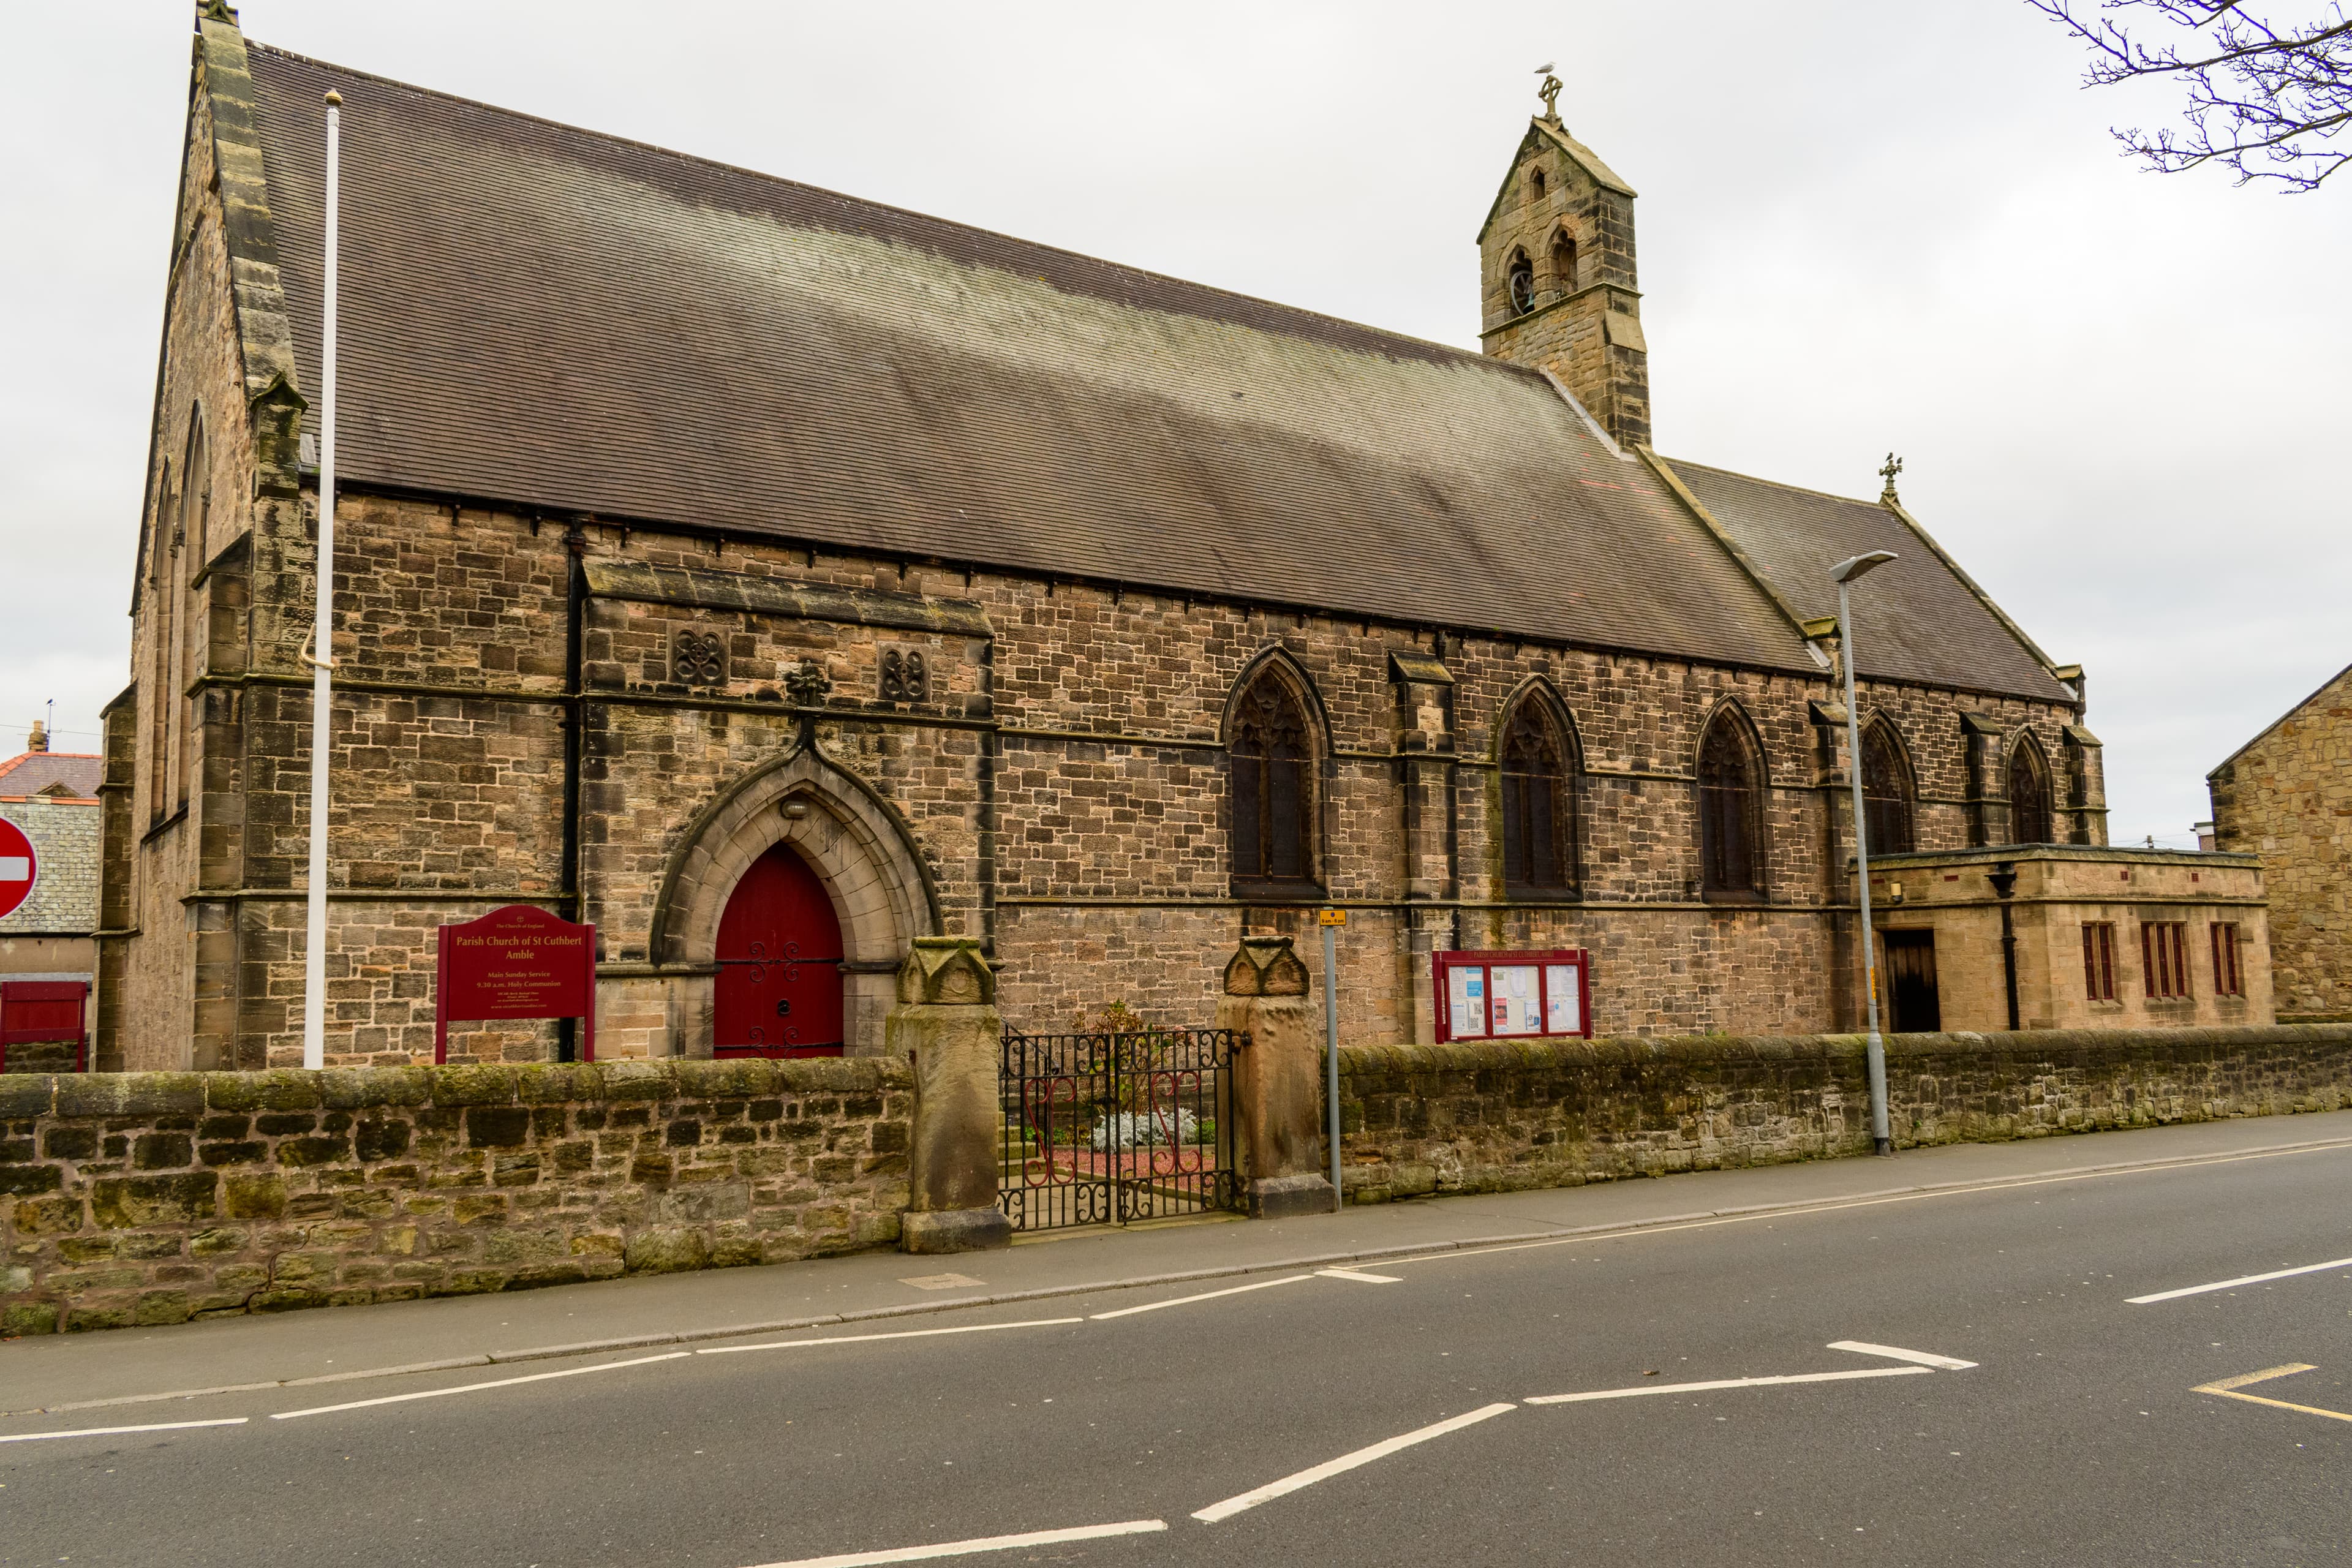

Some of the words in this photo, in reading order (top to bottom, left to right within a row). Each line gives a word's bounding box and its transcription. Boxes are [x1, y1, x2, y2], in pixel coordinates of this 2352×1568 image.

[457, 936, 484, 946] Parish
[486, 936, 519, 946] Church
[521, 936, 531, 946] of
[533, 936, 541, 946] St
[543, 935, 582, 946] Cuthbert
[505, 949, 535, 960] Amble
